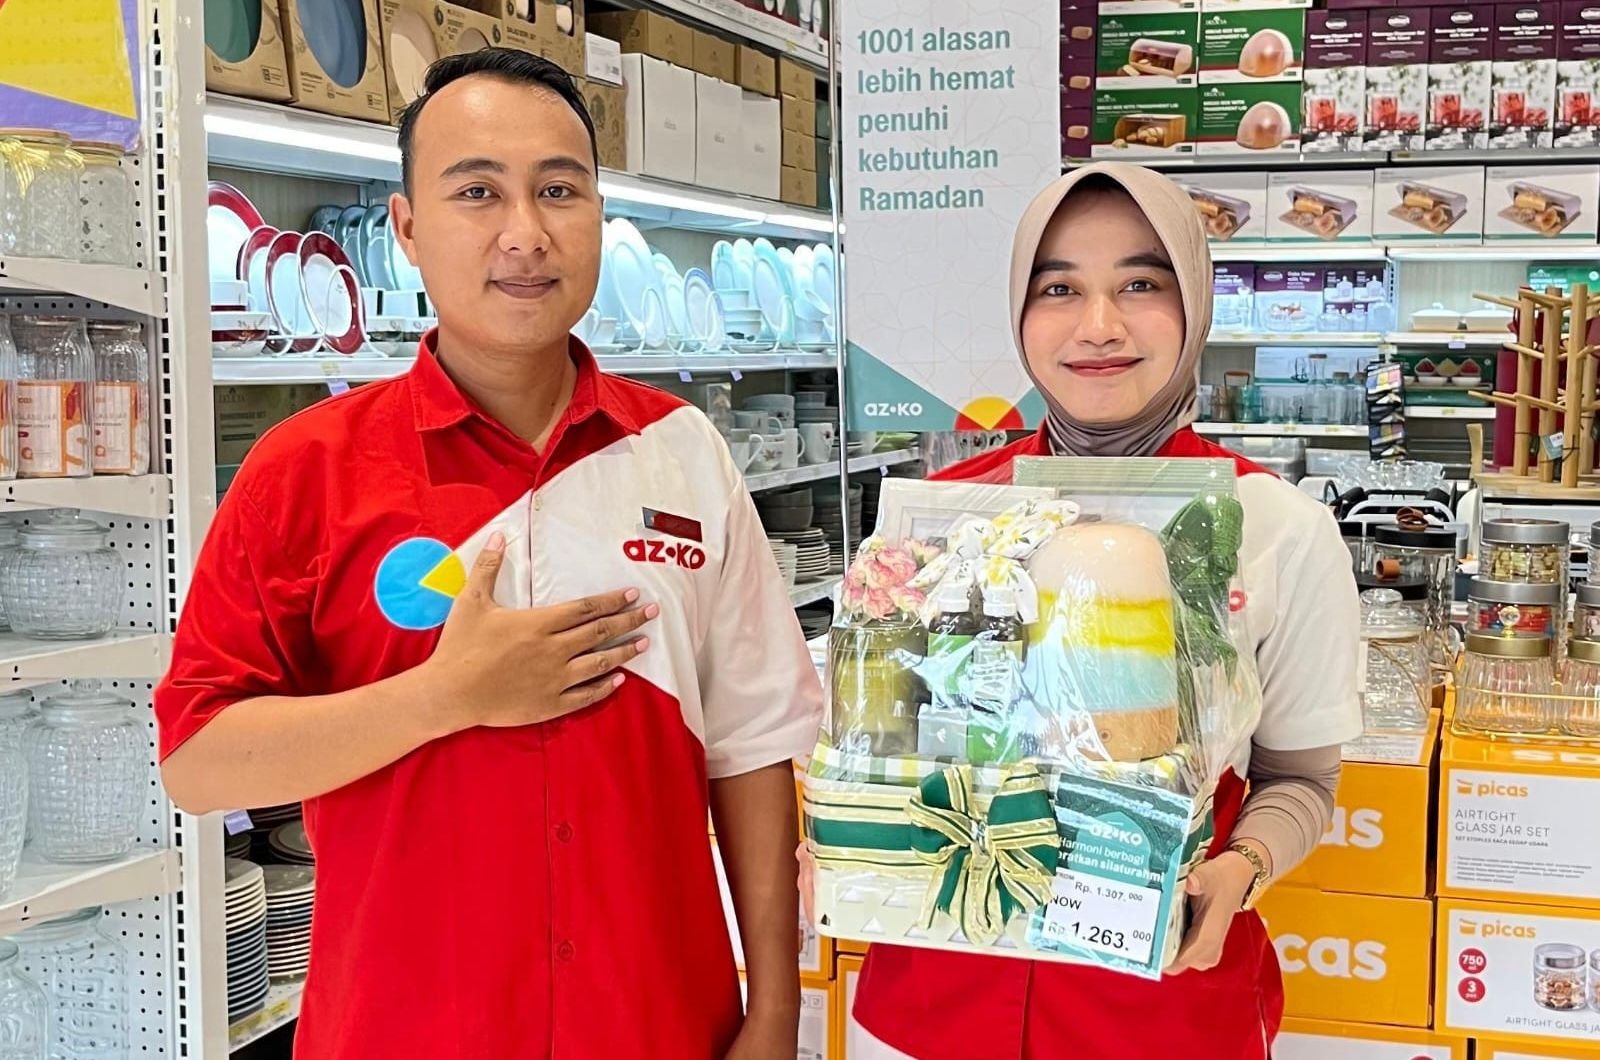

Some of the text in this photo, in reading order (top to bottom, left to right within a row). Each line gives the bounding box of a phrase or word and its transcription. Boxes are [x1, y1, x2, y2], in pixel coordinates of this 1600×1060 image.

[857, 27, 1010, 54] 1001 alasan
[857, 65, 1016, 94] lebih hemat
[858, 105, 949, 138] penuhi
[858, 146, 999, 172] kebutuhan
[860, 185, 984, 211] Ramadan
[1476, 780, 1529, 798] picas
[1455, 808, 1518, 822] AIRTIGHT
[1455, 821, 1550, 838] GLASS JAR SET
[1104, 846, 1144, 866] berbagi
[1481, 920, 1536, 939] picas
[1270, 932, 1388, 981] cas
[1461, 954, 1484, 966] 750
[1468, 980, 1477, 993] 3
[1505, 1016, 1552, 1028] AIRTIGHT
[1555, 1020, 1587, 1031] GLASS
